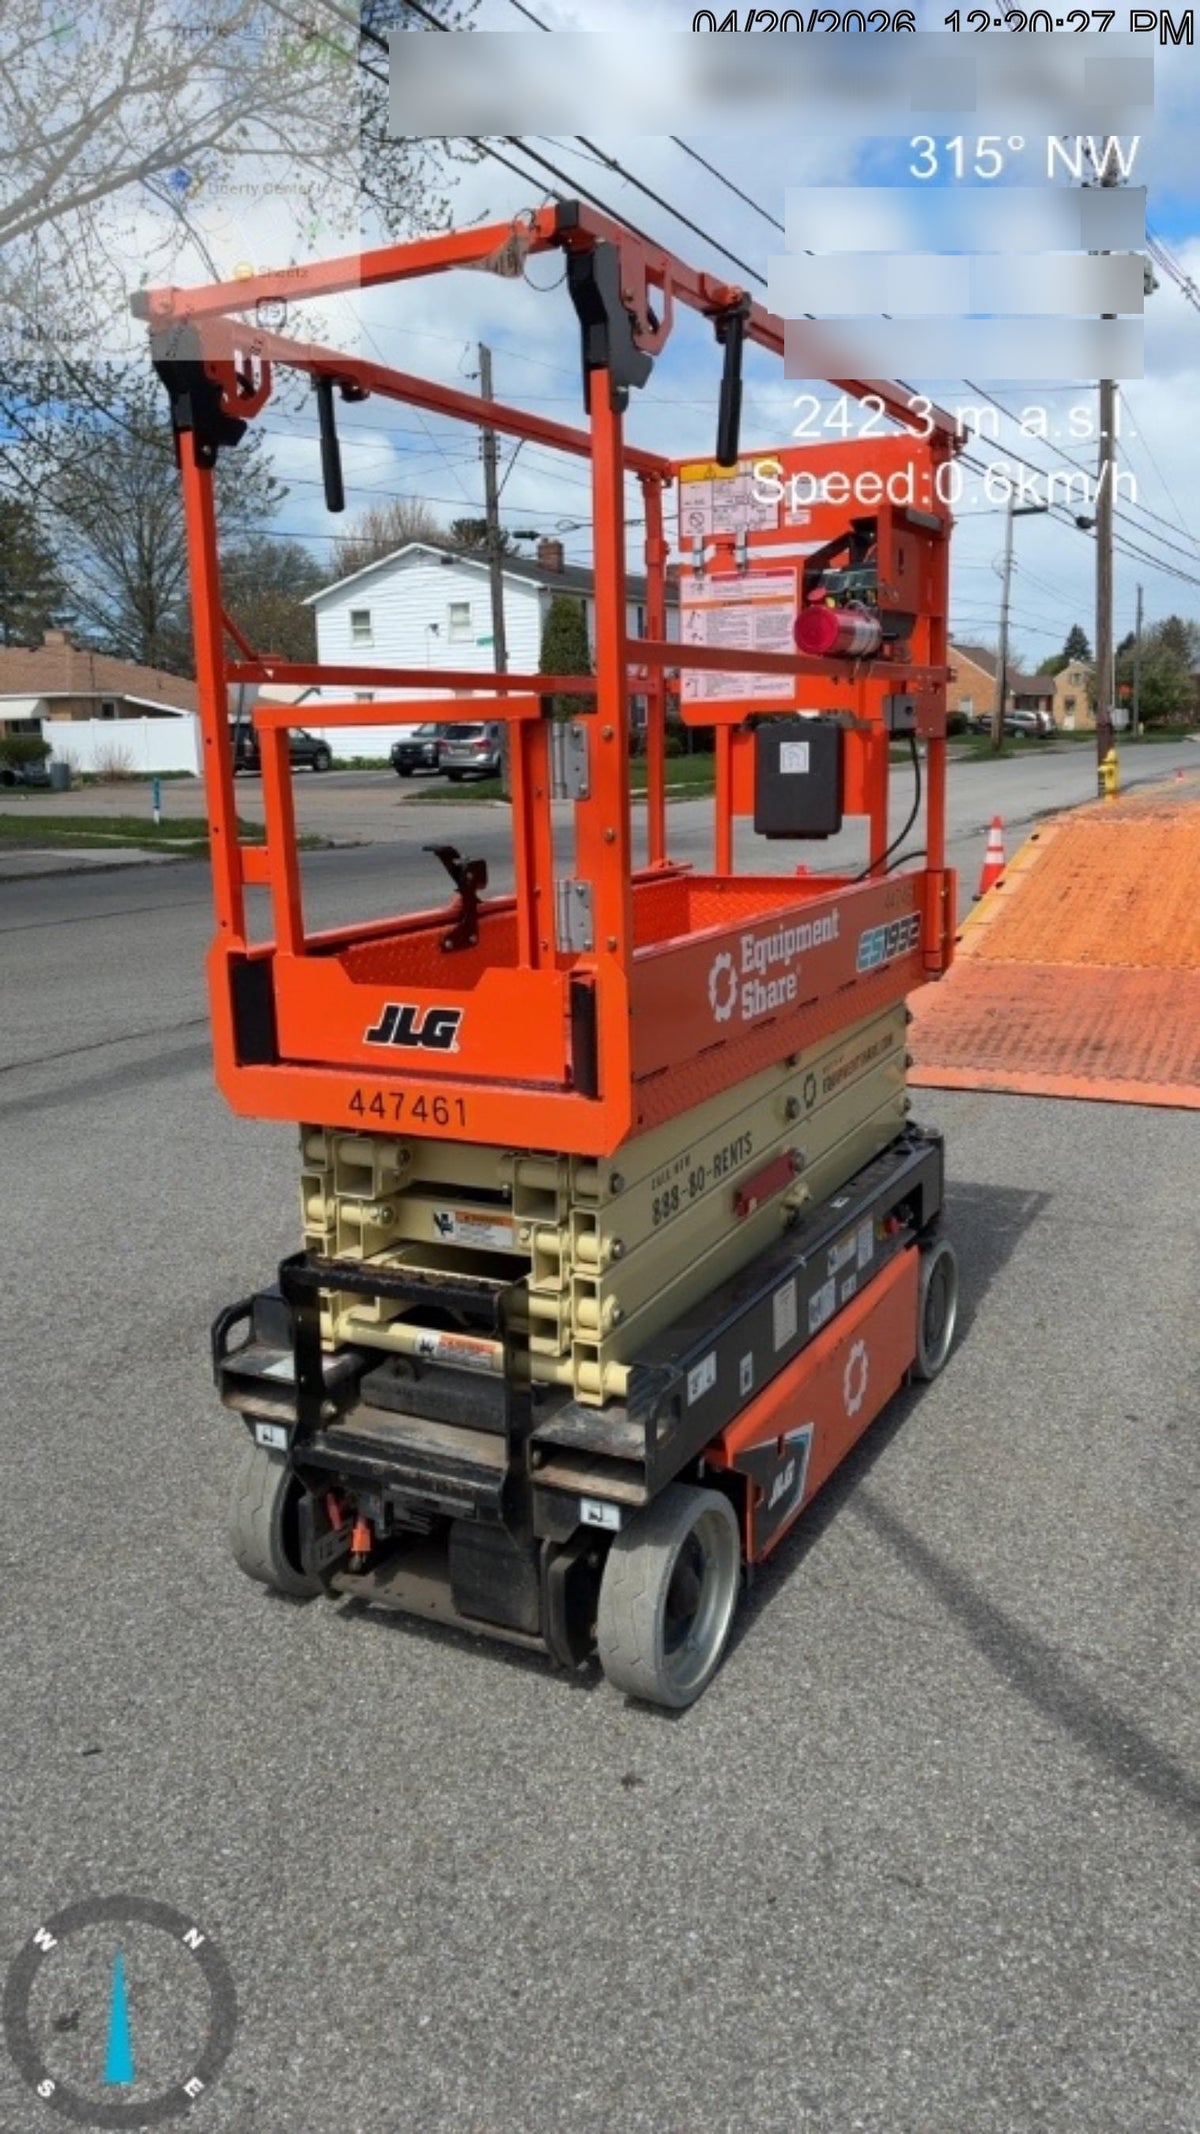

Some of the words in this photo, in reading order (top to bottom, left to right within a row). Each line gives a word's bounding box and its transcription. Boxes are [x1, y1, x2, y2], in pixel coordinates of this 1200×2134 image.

[740, 907, 840, 975] Equipment
[741, 971, 798, 1021] Share
[364, 1003, 464, 1051] JLG
[349, 1089, 467, 1127] 447461
